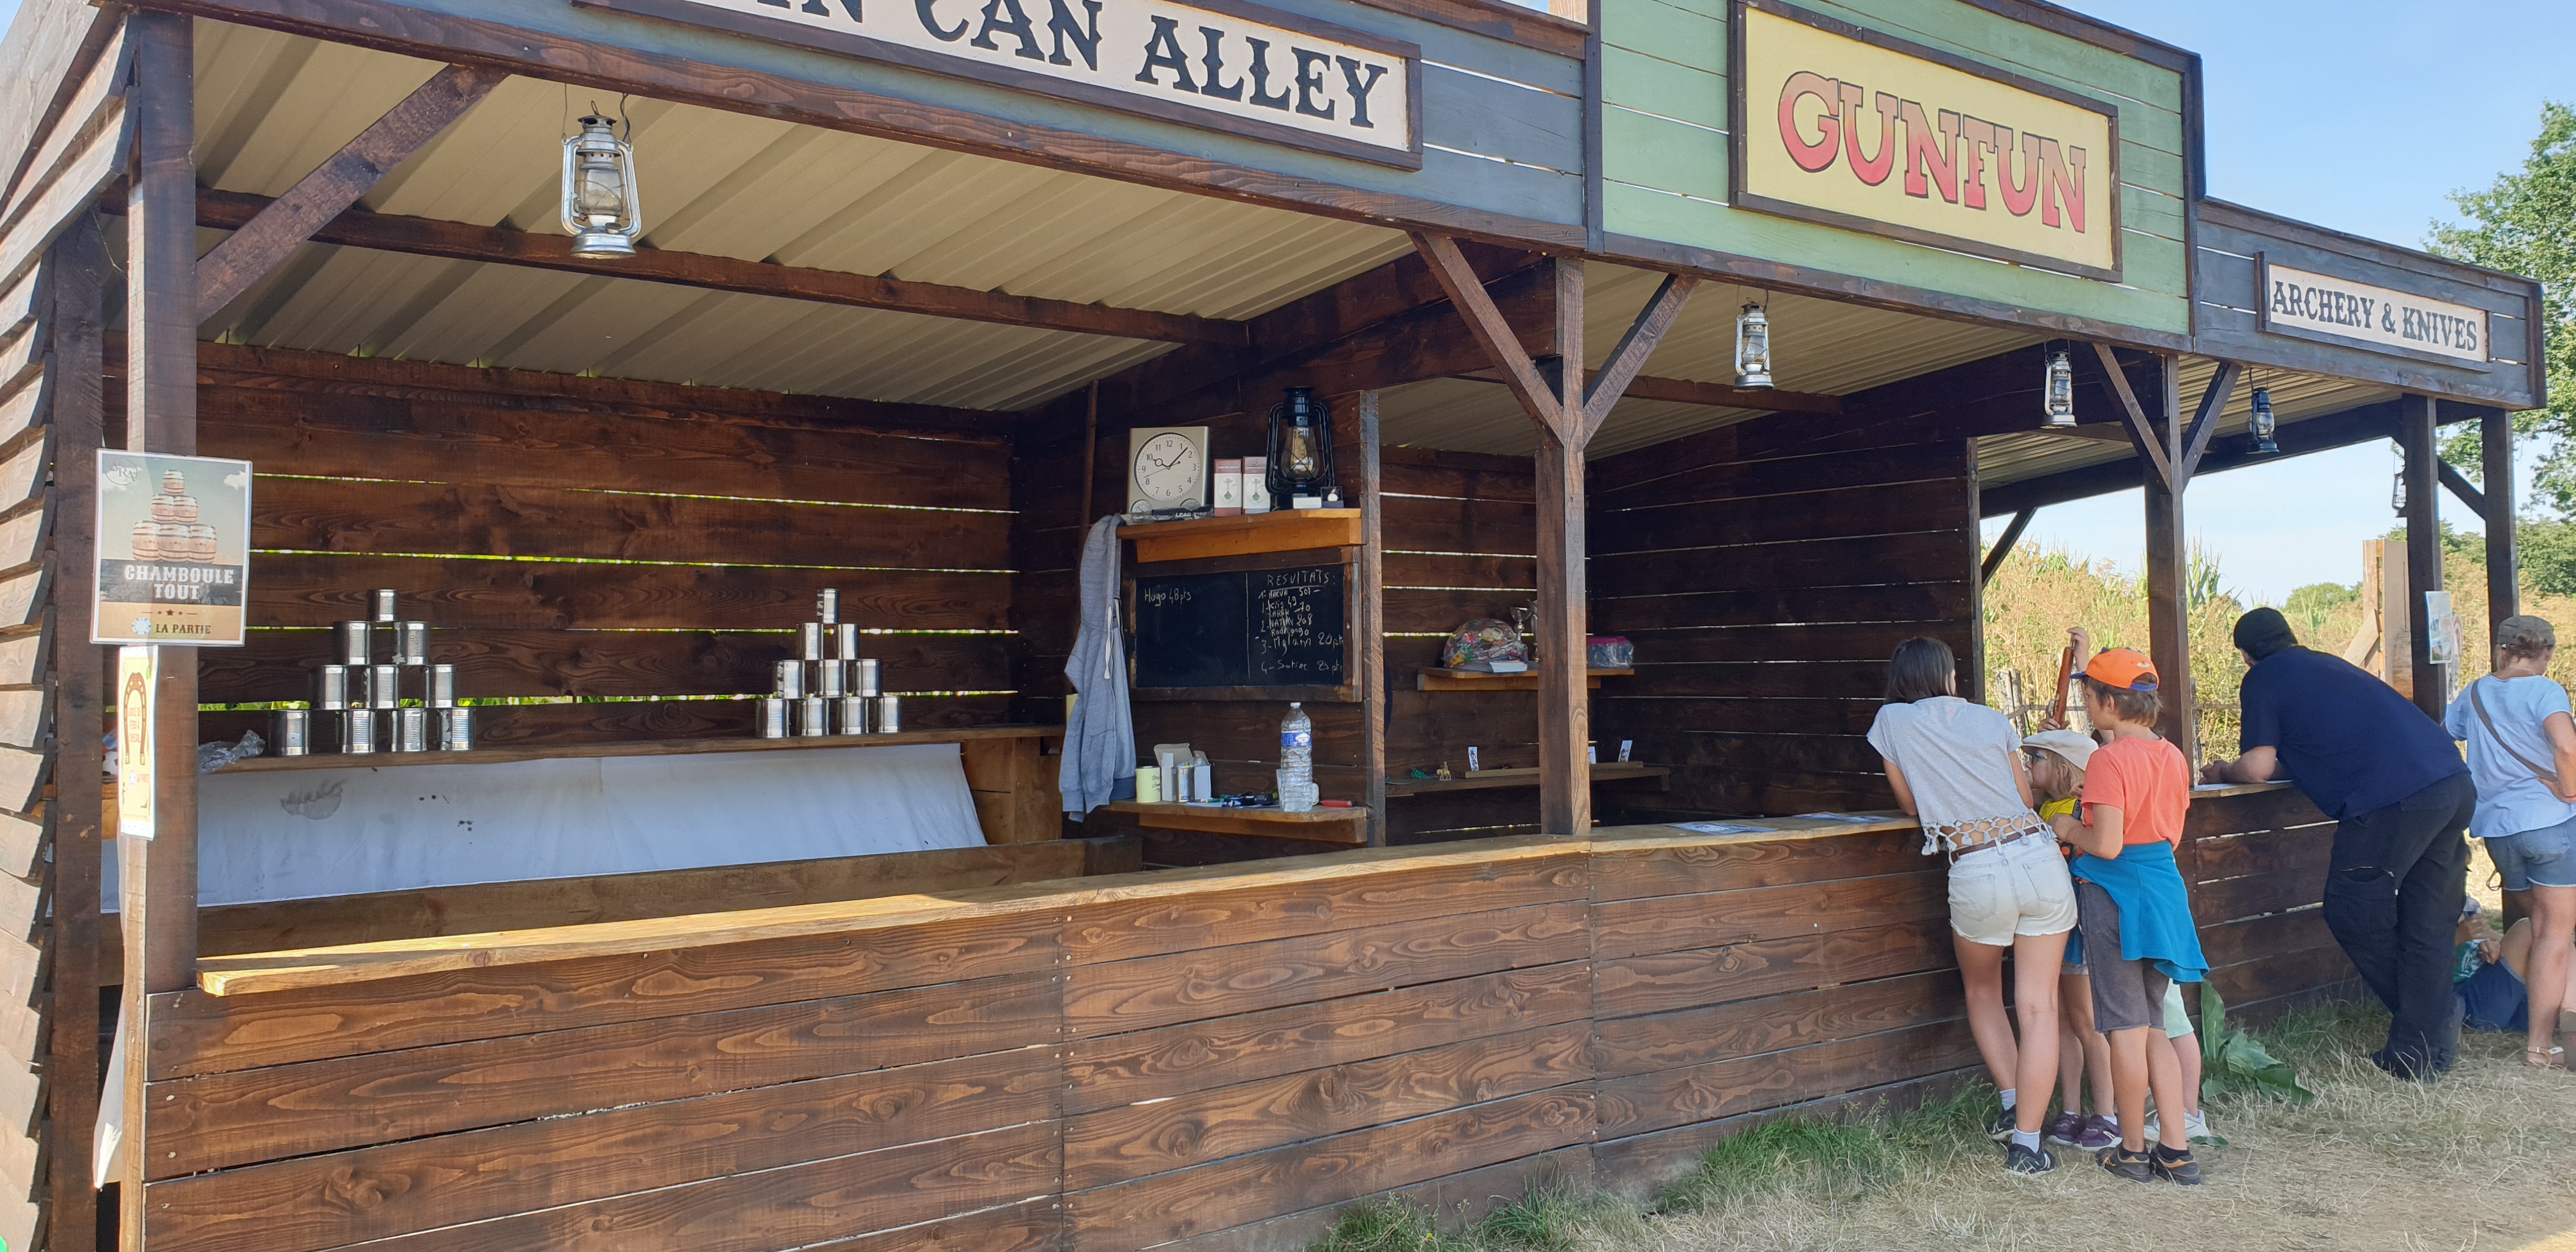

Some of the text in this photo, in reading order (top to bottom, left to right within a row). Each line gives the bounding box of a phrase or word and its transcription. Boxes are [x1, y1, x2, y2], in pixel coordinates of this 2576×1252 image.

[1135, 15, 1388, 129] ALLEY
[1777, 71, 2086, 234] GUNFUN
[2271, 281, 2477, 352] ARCHERY & KNIVES
[124, 565, 234, 584] CHAMBOULE
[153, 583, 200, 600] TOUT
[1144, 588, 1167, 606] Hugo
[155, 623, 211, 634] LA PARTIE
